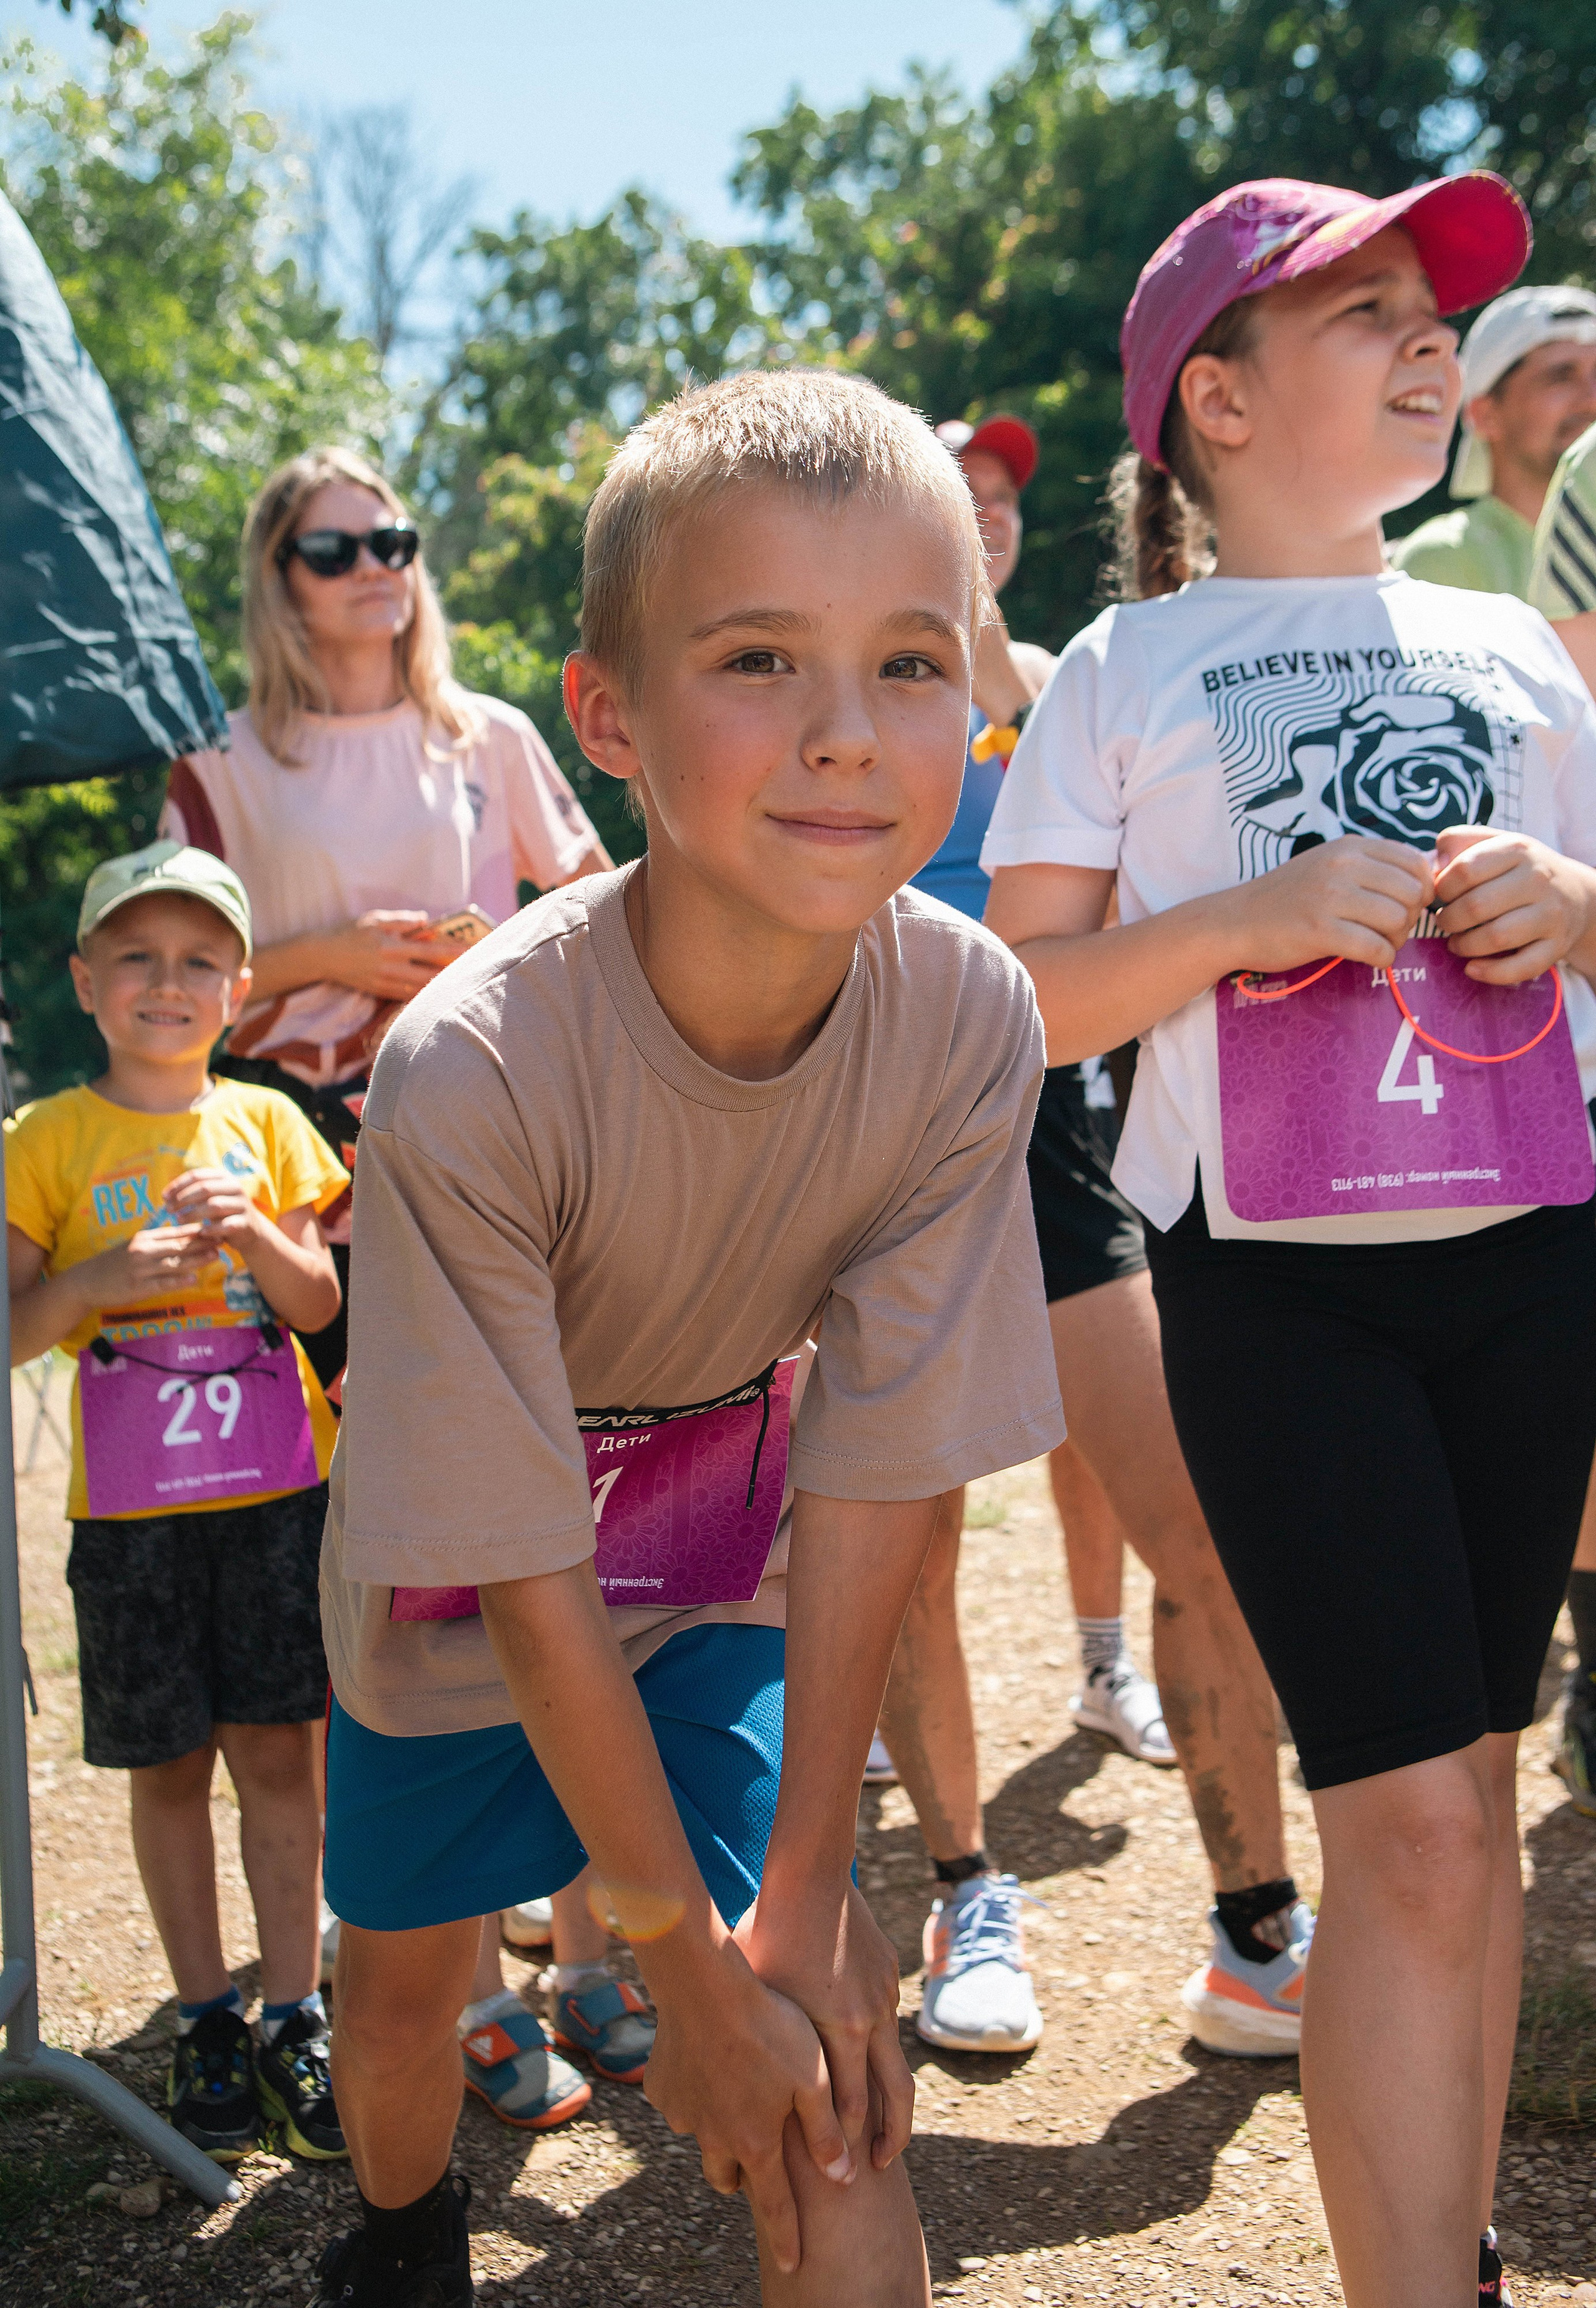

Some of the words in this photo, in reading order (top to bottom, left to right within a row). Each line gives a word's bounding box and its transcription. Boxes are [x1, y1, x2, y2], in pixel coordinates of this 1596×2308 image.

[1203, 651, 1320, 693] BELIEVE
[1324, 650, 1353, 674] IN
[1372, 967, 1426, 988] Дети
[1377, 1015, 1444, 1114] 4
[92, 1174, 155, 1227] REX
[157, 1374, 242, 1447] 29
[575, 1414, 659, 1427] EARL
[597, 1434, 651, 1454] Дети
[592, 1466, 624, 1523] 1
[608, 1576, 665, 1591] Экстренный
